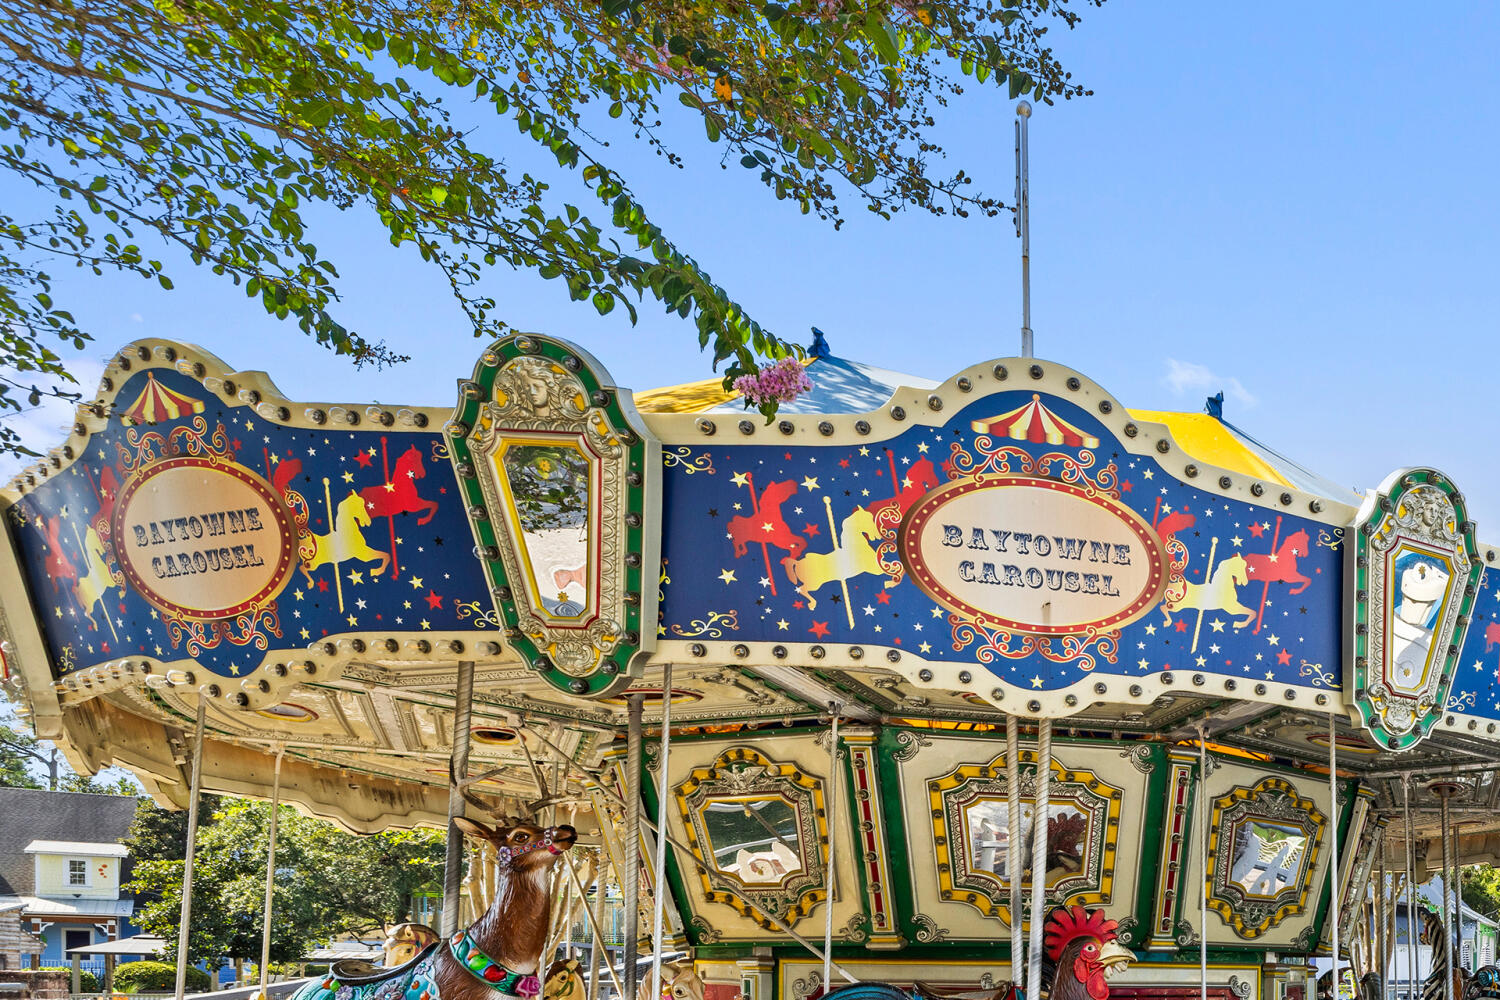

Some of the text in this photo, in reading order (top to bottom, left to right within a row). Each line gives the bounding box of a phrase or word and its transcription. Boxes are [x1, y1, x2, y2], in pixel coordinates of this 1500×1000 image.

[132, 506, 264, 547] BAYTOWNE
[941, 523, 1132, 567] BAYTOWNE
[151, 543, 265, 579] CAROUSEL
[957, 560, 1121, 597] CAROUSEL
